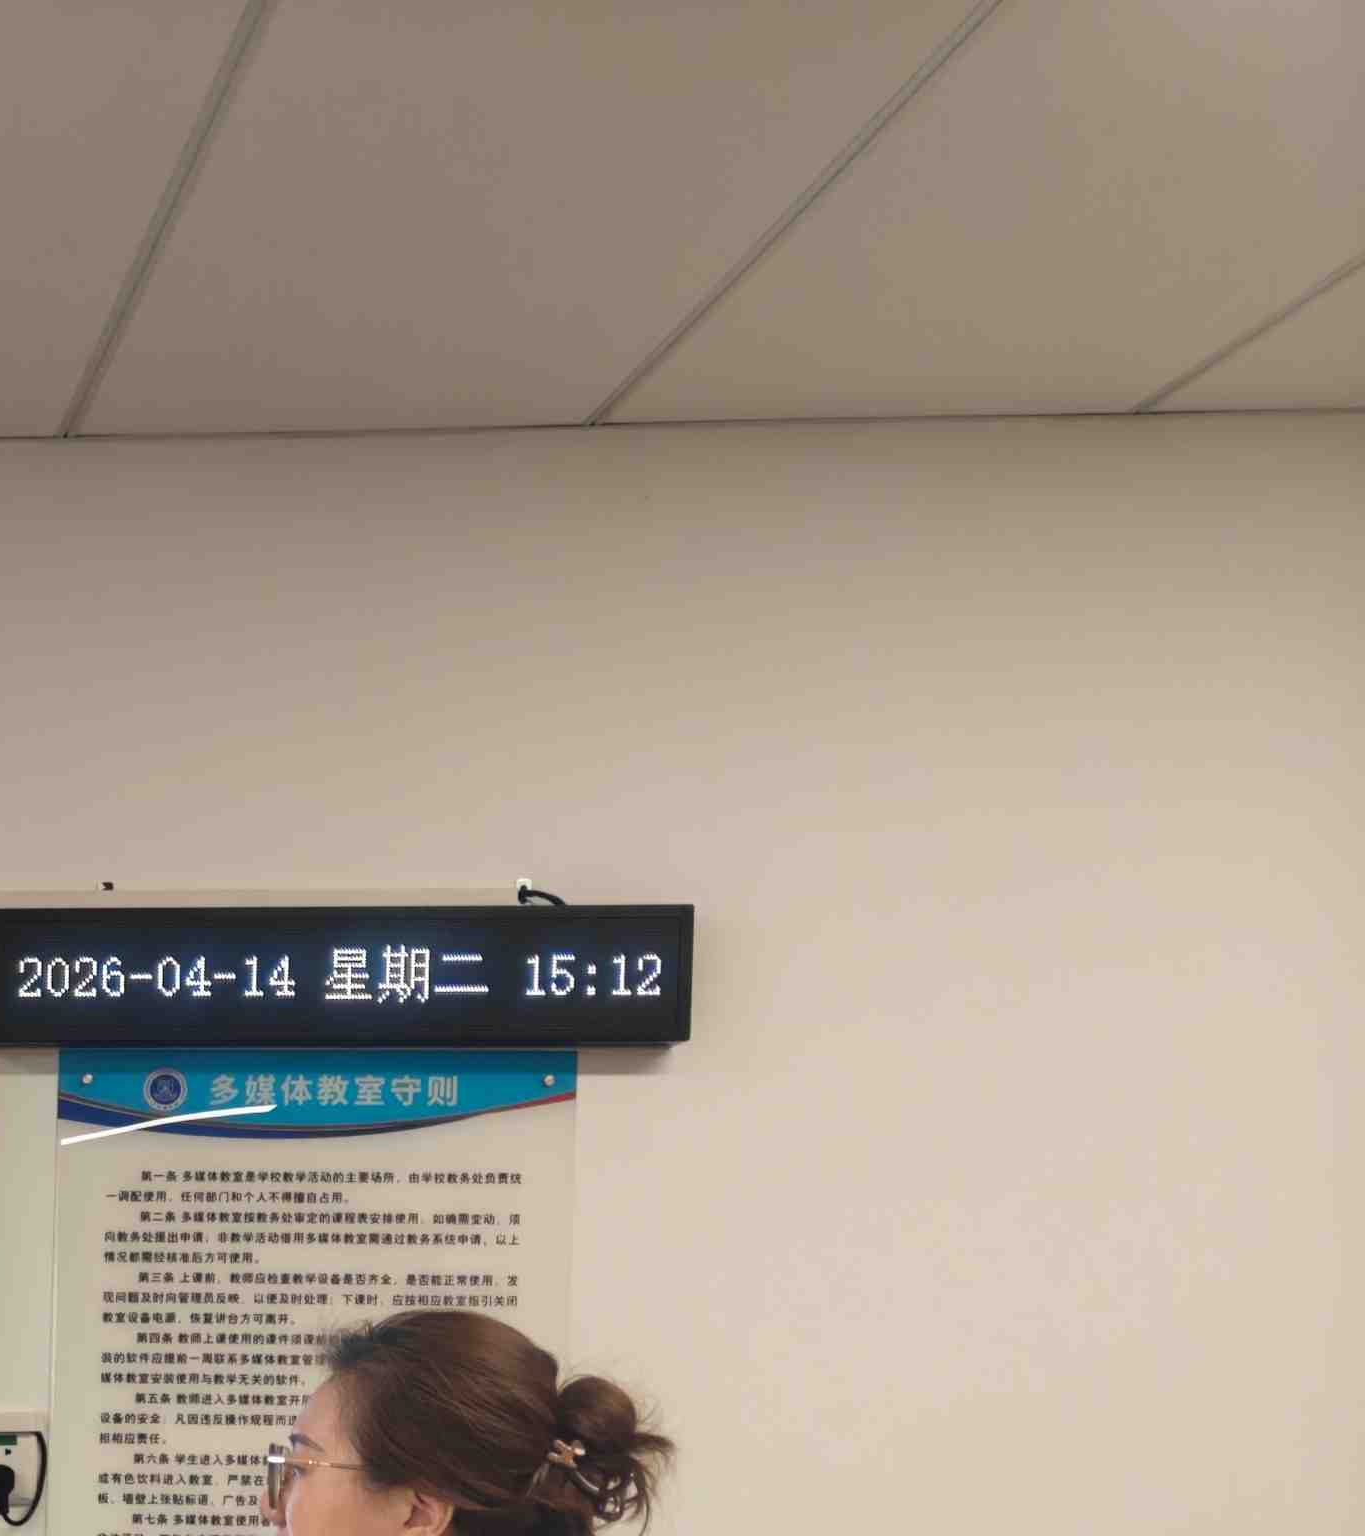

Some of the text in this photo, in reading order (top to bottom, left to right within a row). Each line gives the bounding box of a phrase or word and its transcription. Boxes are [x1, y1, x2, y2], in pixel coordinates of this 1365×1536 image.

[18, 944, 661, 1004] 2026-04-14 星期二 15:12
[209, 1074, 459, 1107] 多媒体教室守则
[140, 1170, 179, 1183] 第一条
[138, 1210, 176, 1224] 第二条
[137, 1272, 175, 1284] 第三条
[135, 1332, 173, 1344] 第四条
[133, 1392, 172, 1405] 第五条
[132, 1452, 170, 1465] 第六条
[130, 1513, 169, 1528] 第七条
